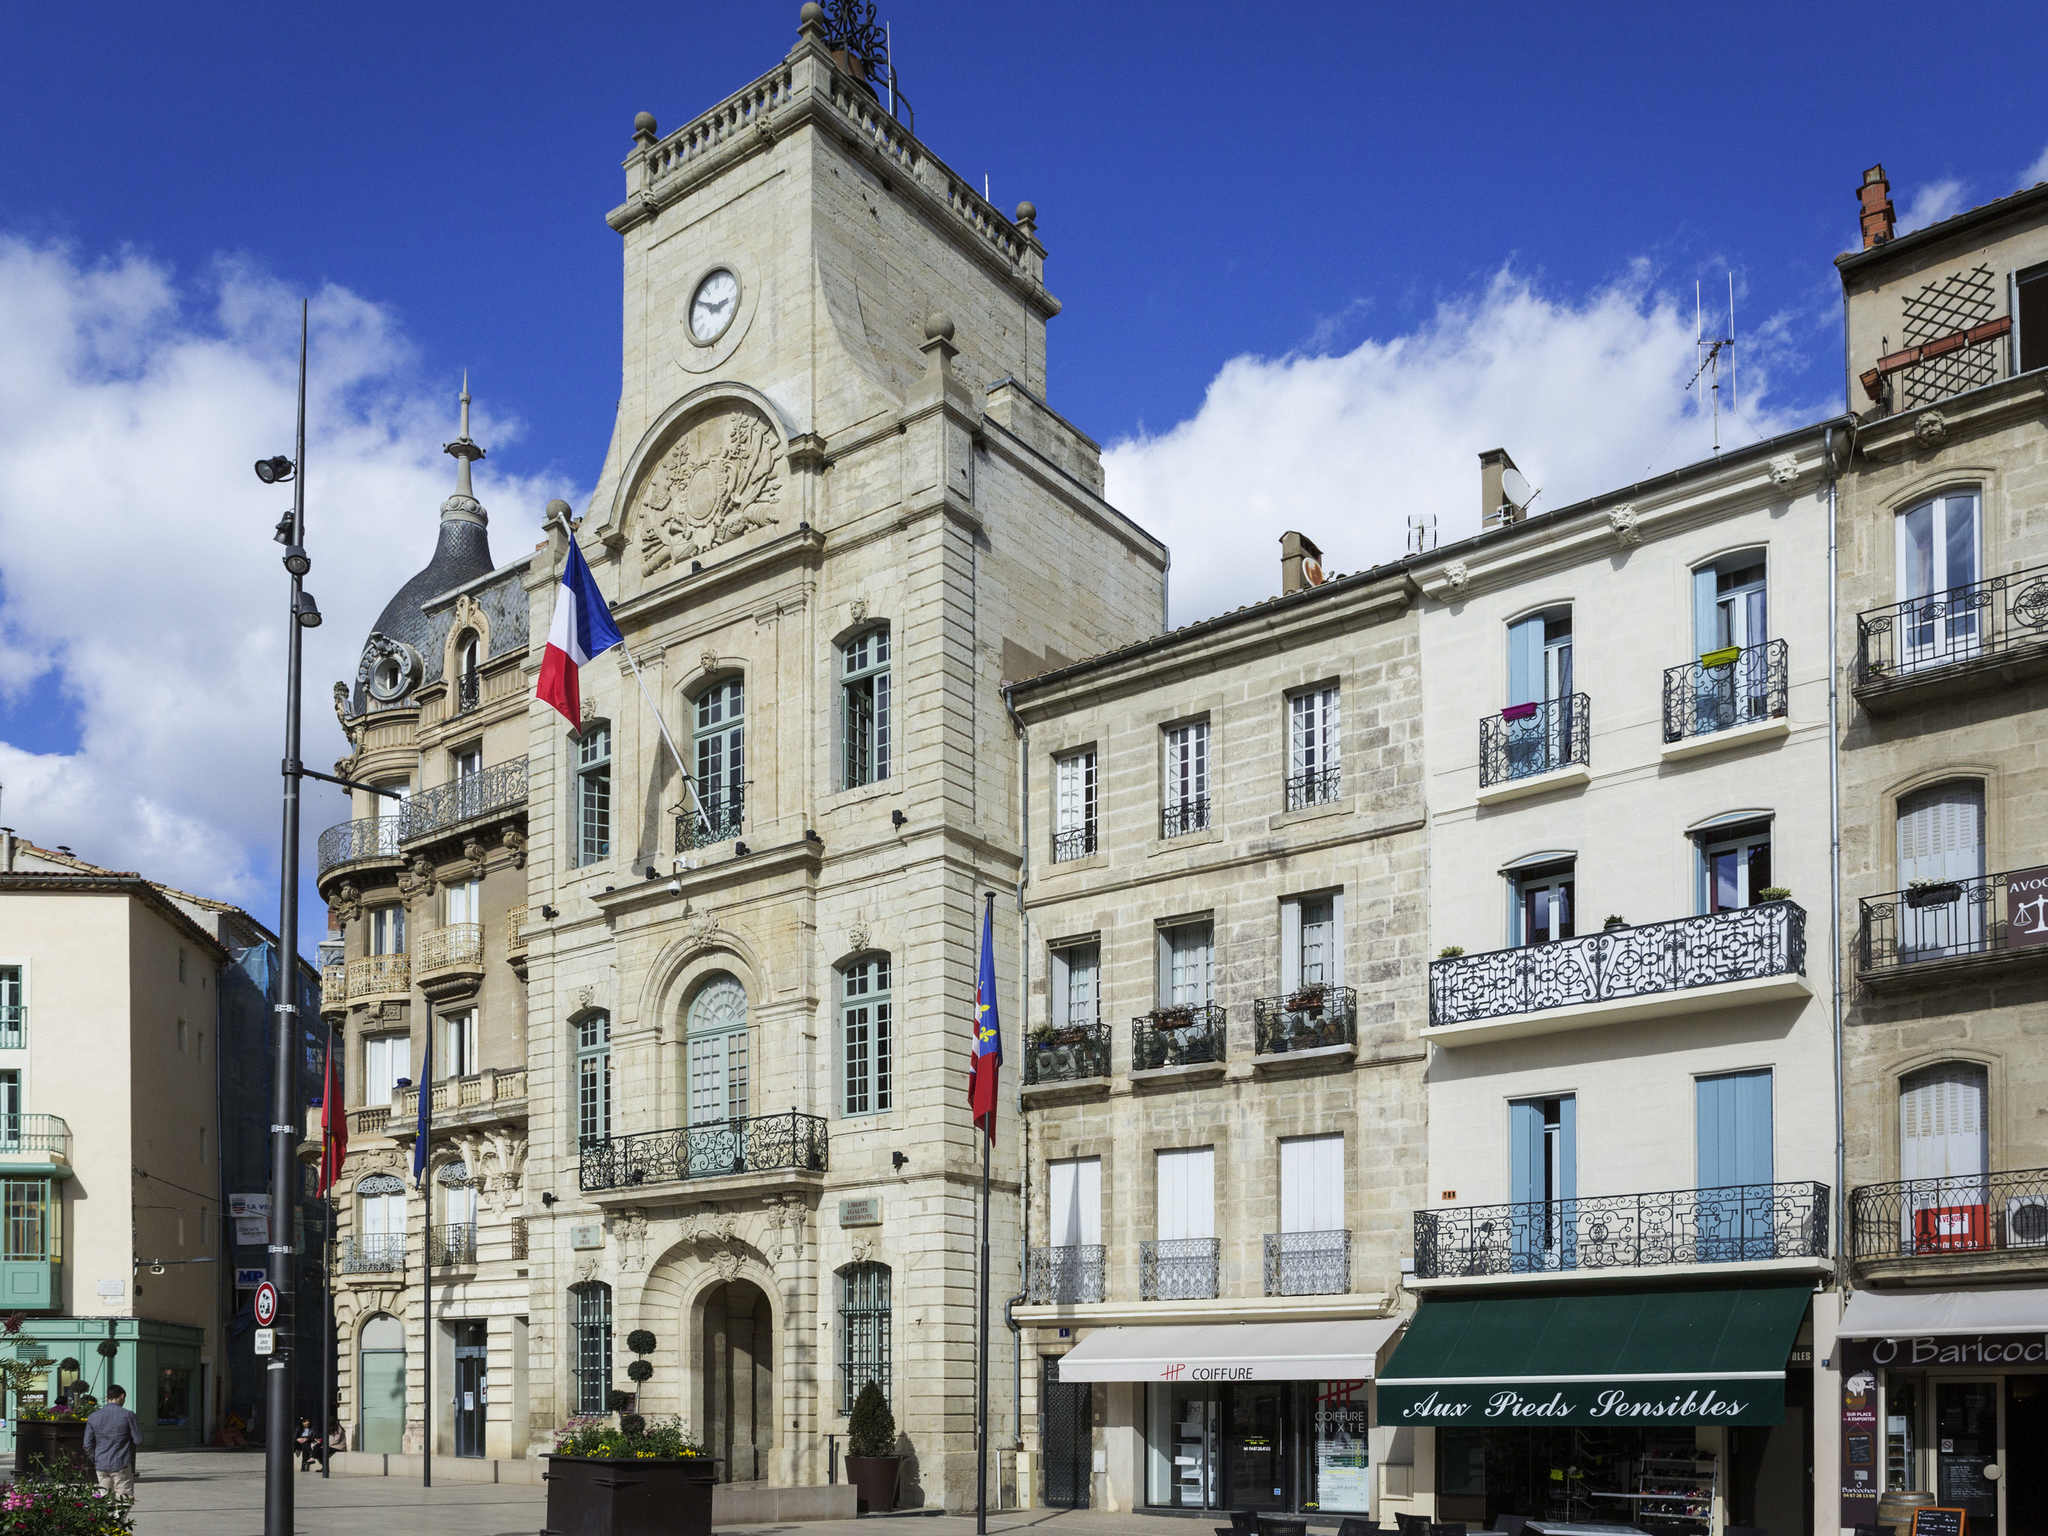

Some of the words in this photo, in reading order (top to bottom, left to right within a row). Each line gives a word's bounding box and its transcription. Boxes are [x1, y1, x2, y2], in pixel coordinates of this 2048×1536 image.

[1912, 1334, 2048, 1363] Baricoc
[1191, 1367, 1254, 1381] COIFFURE
[1402, 1391, 1471, 1418] Aux
[1484, 1390, 1576, 1418] Pieds
[1589, 1389, 1749, 1417] Sensibles
[1314, 1411, 1365, 1422] COIFFURE
[1314, 1423, 1365, 1433] MIXTE
